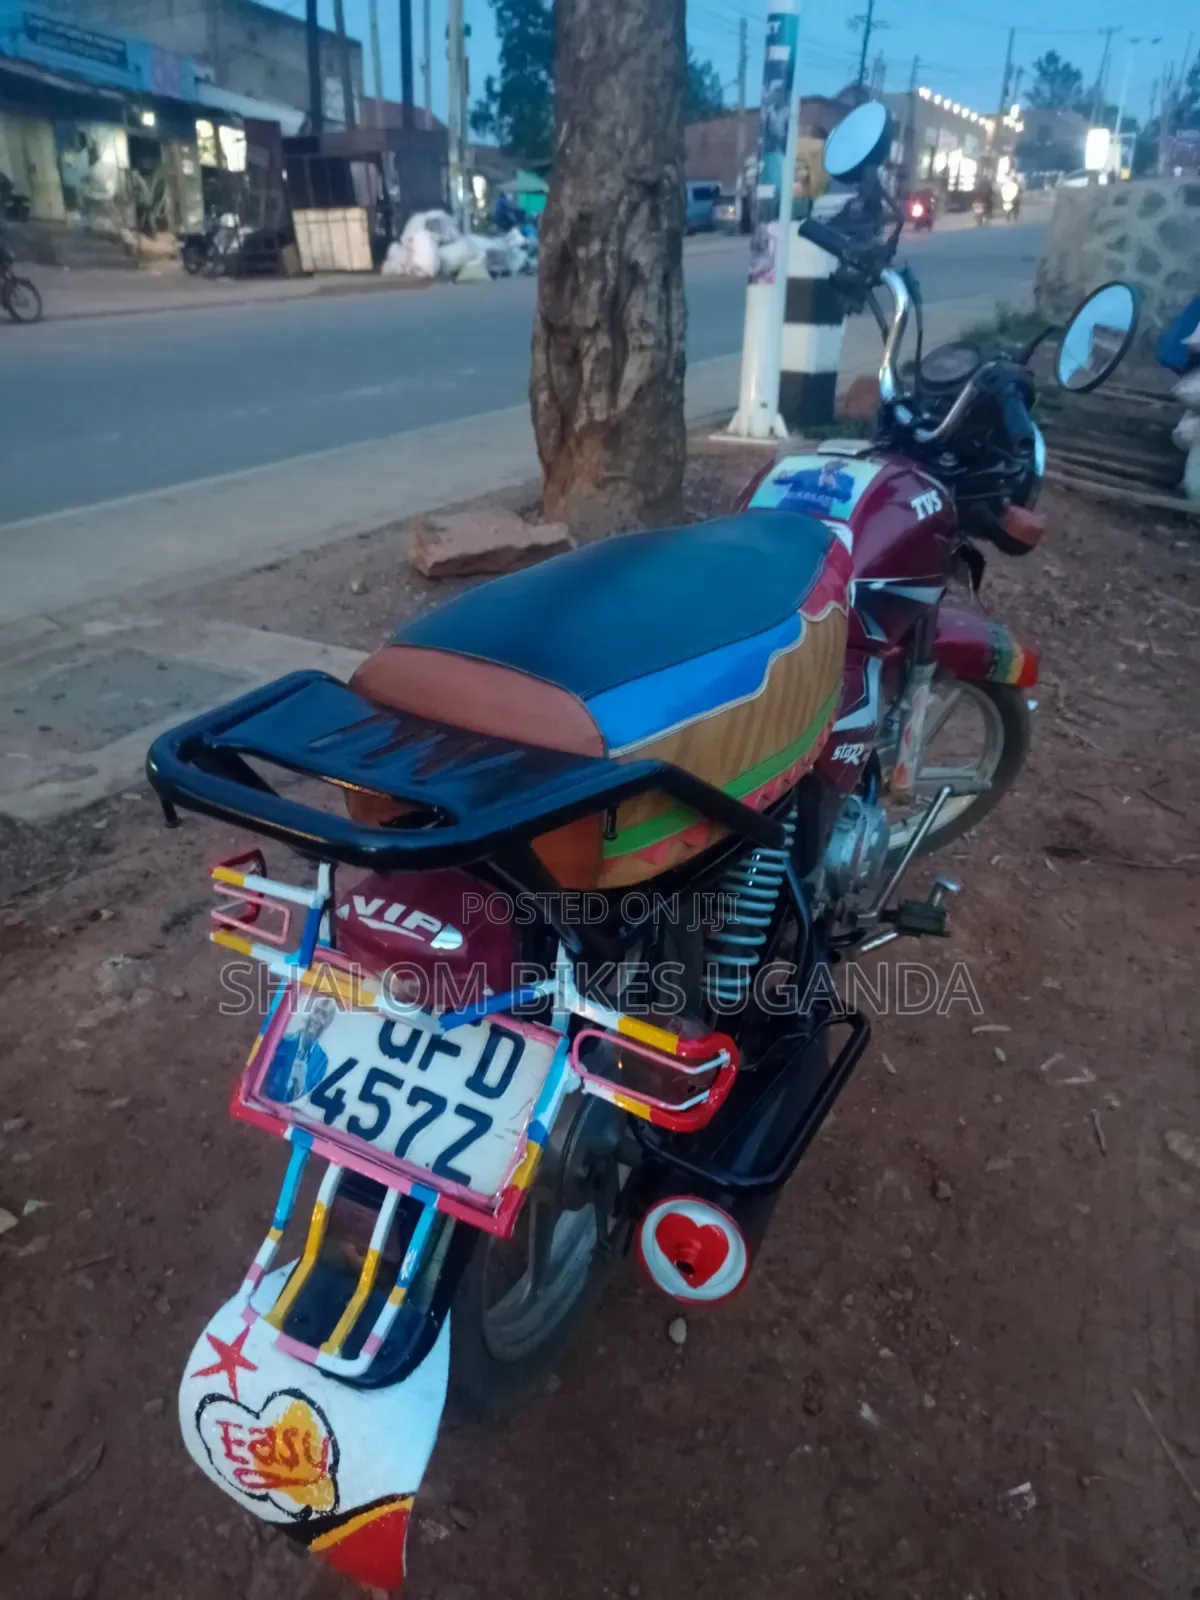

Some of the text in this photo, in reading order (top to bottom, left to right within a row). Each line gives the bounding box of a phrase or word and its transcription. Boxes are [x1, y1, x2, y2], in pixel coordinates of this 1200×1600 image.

[911, 490, 942, 521] TVS
[352, 894, 443, 934] VIP
[216, 1419, 330, 1490] Easy
